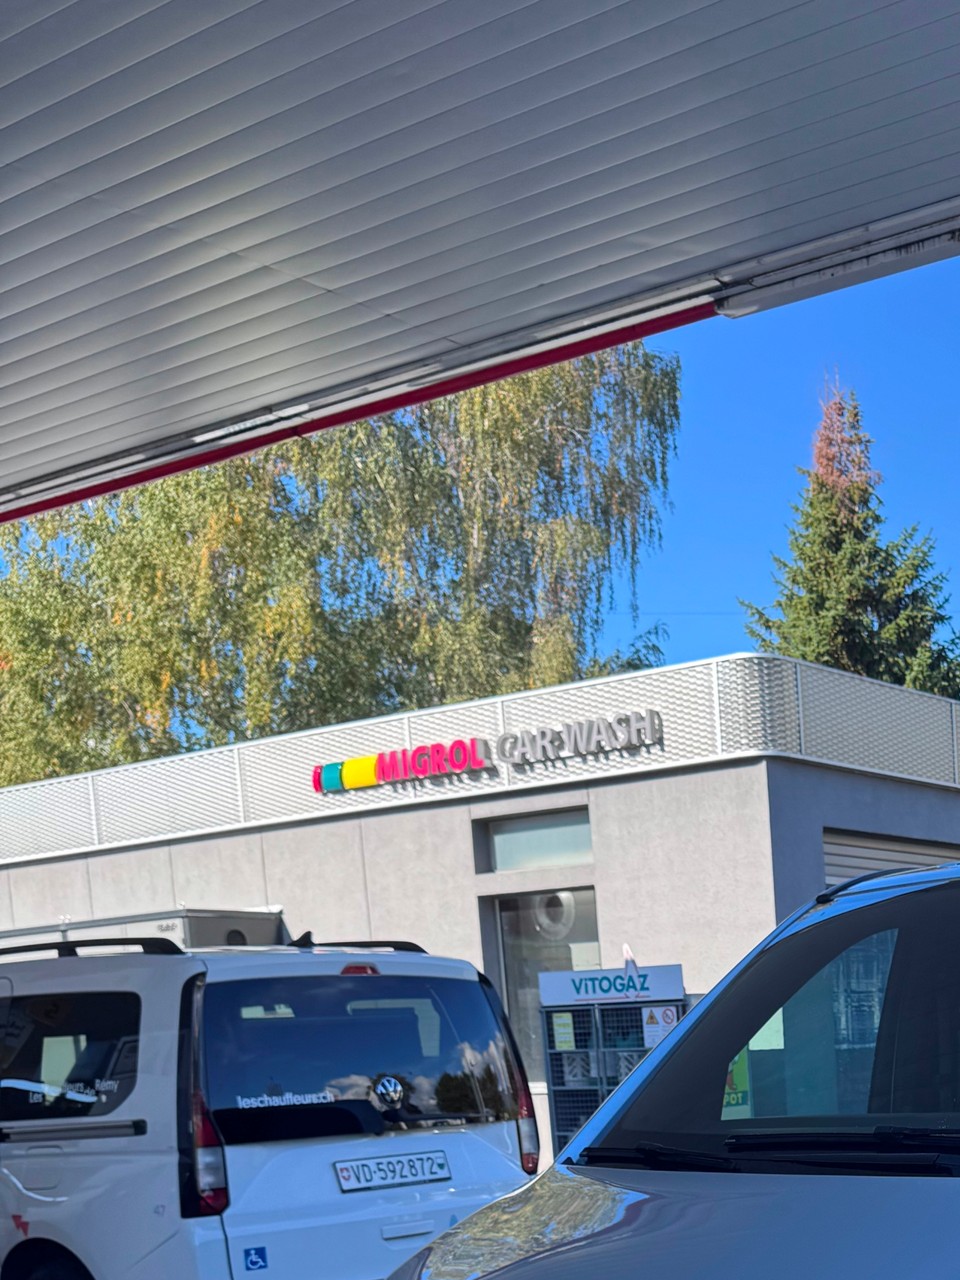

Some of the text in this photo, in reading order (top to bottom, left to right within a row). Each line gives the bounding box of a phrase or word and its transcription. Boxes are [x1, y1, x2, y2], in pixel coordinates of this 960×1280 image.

[375, 709, 658, 782] MIGROL CAR WASH
[235, 1090, 336, 1109] leschauffeurs.ch
